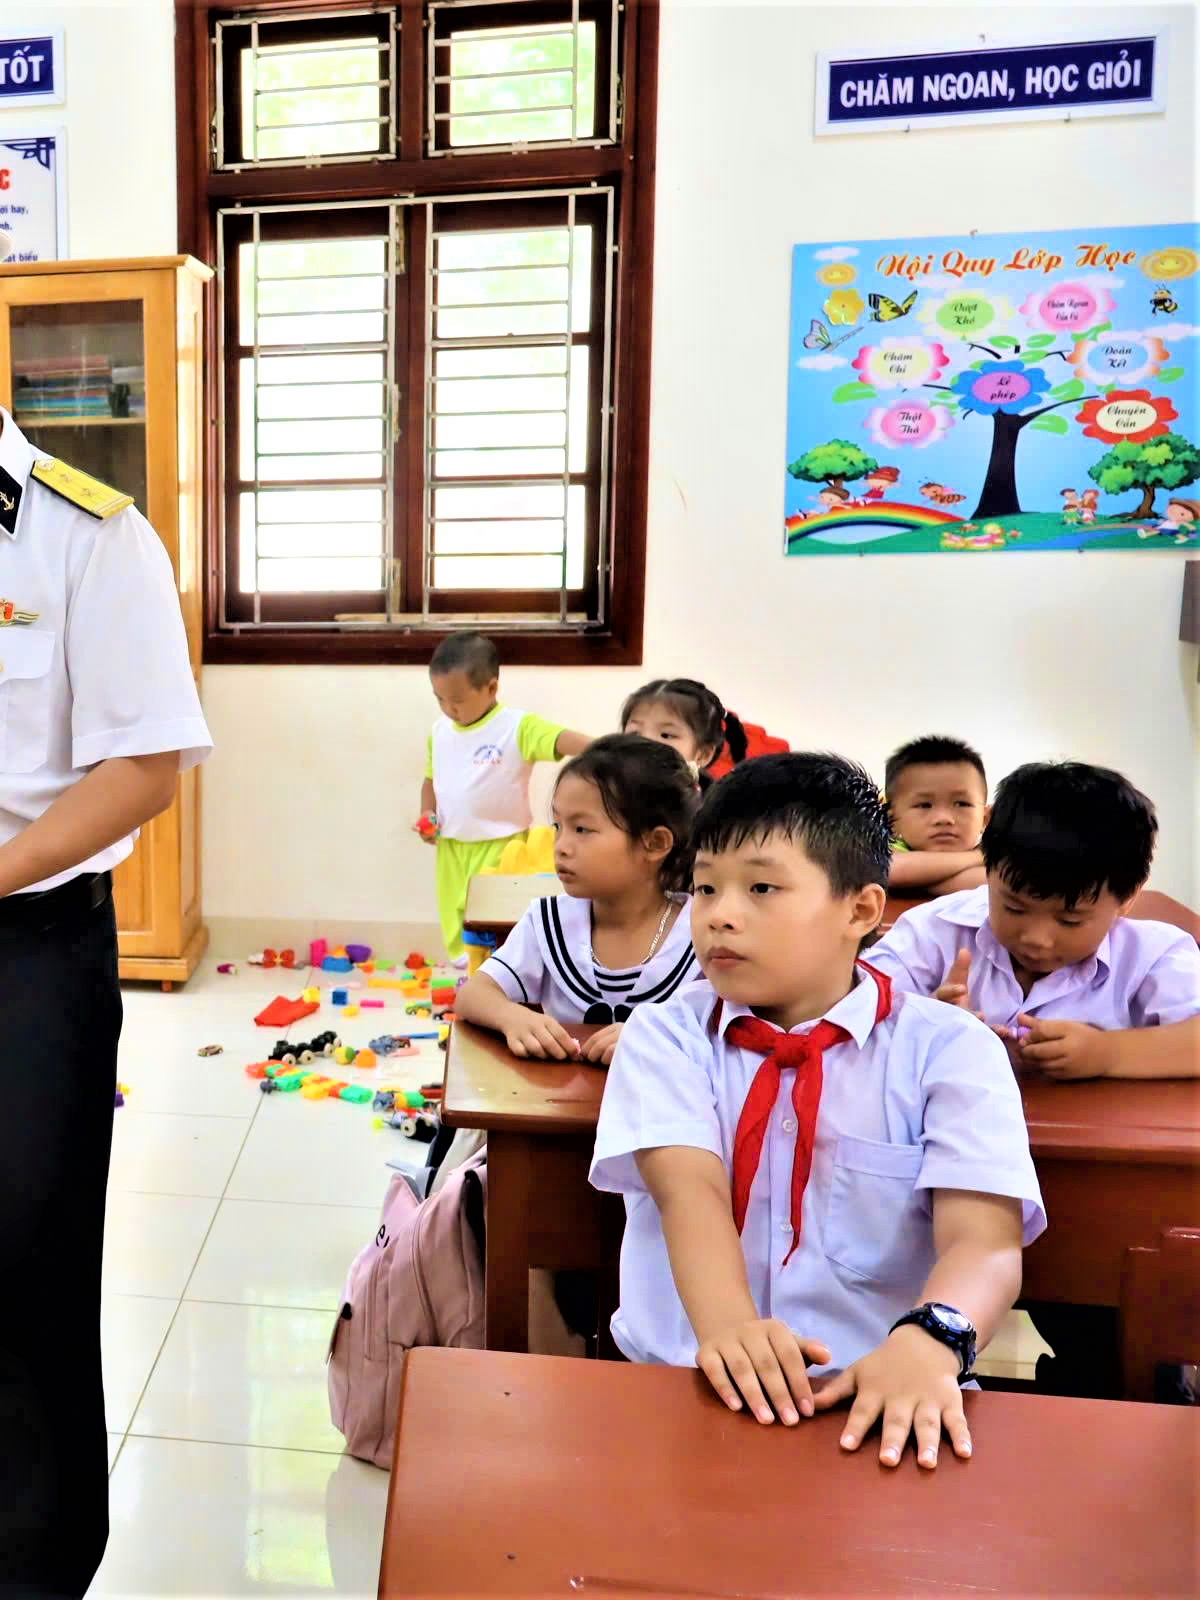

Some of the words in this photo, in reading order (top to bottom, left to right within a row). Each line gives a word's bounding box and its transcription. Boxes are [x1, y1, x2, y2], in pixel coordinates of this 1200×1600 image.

[839, 73, 914, 108] CHĂM
[923, 70, 1015, 102] NGOAN,
[1025, 64, 1080, 98] HỌC
[1087, 49, 1141, 91] GIỎI
[876, 254, 934, 281] Nội
[941, 249, 998, 278] Quy
[1003, 248, 1063, 273] Lớp
[1075, 244, 1137, 271] Học
